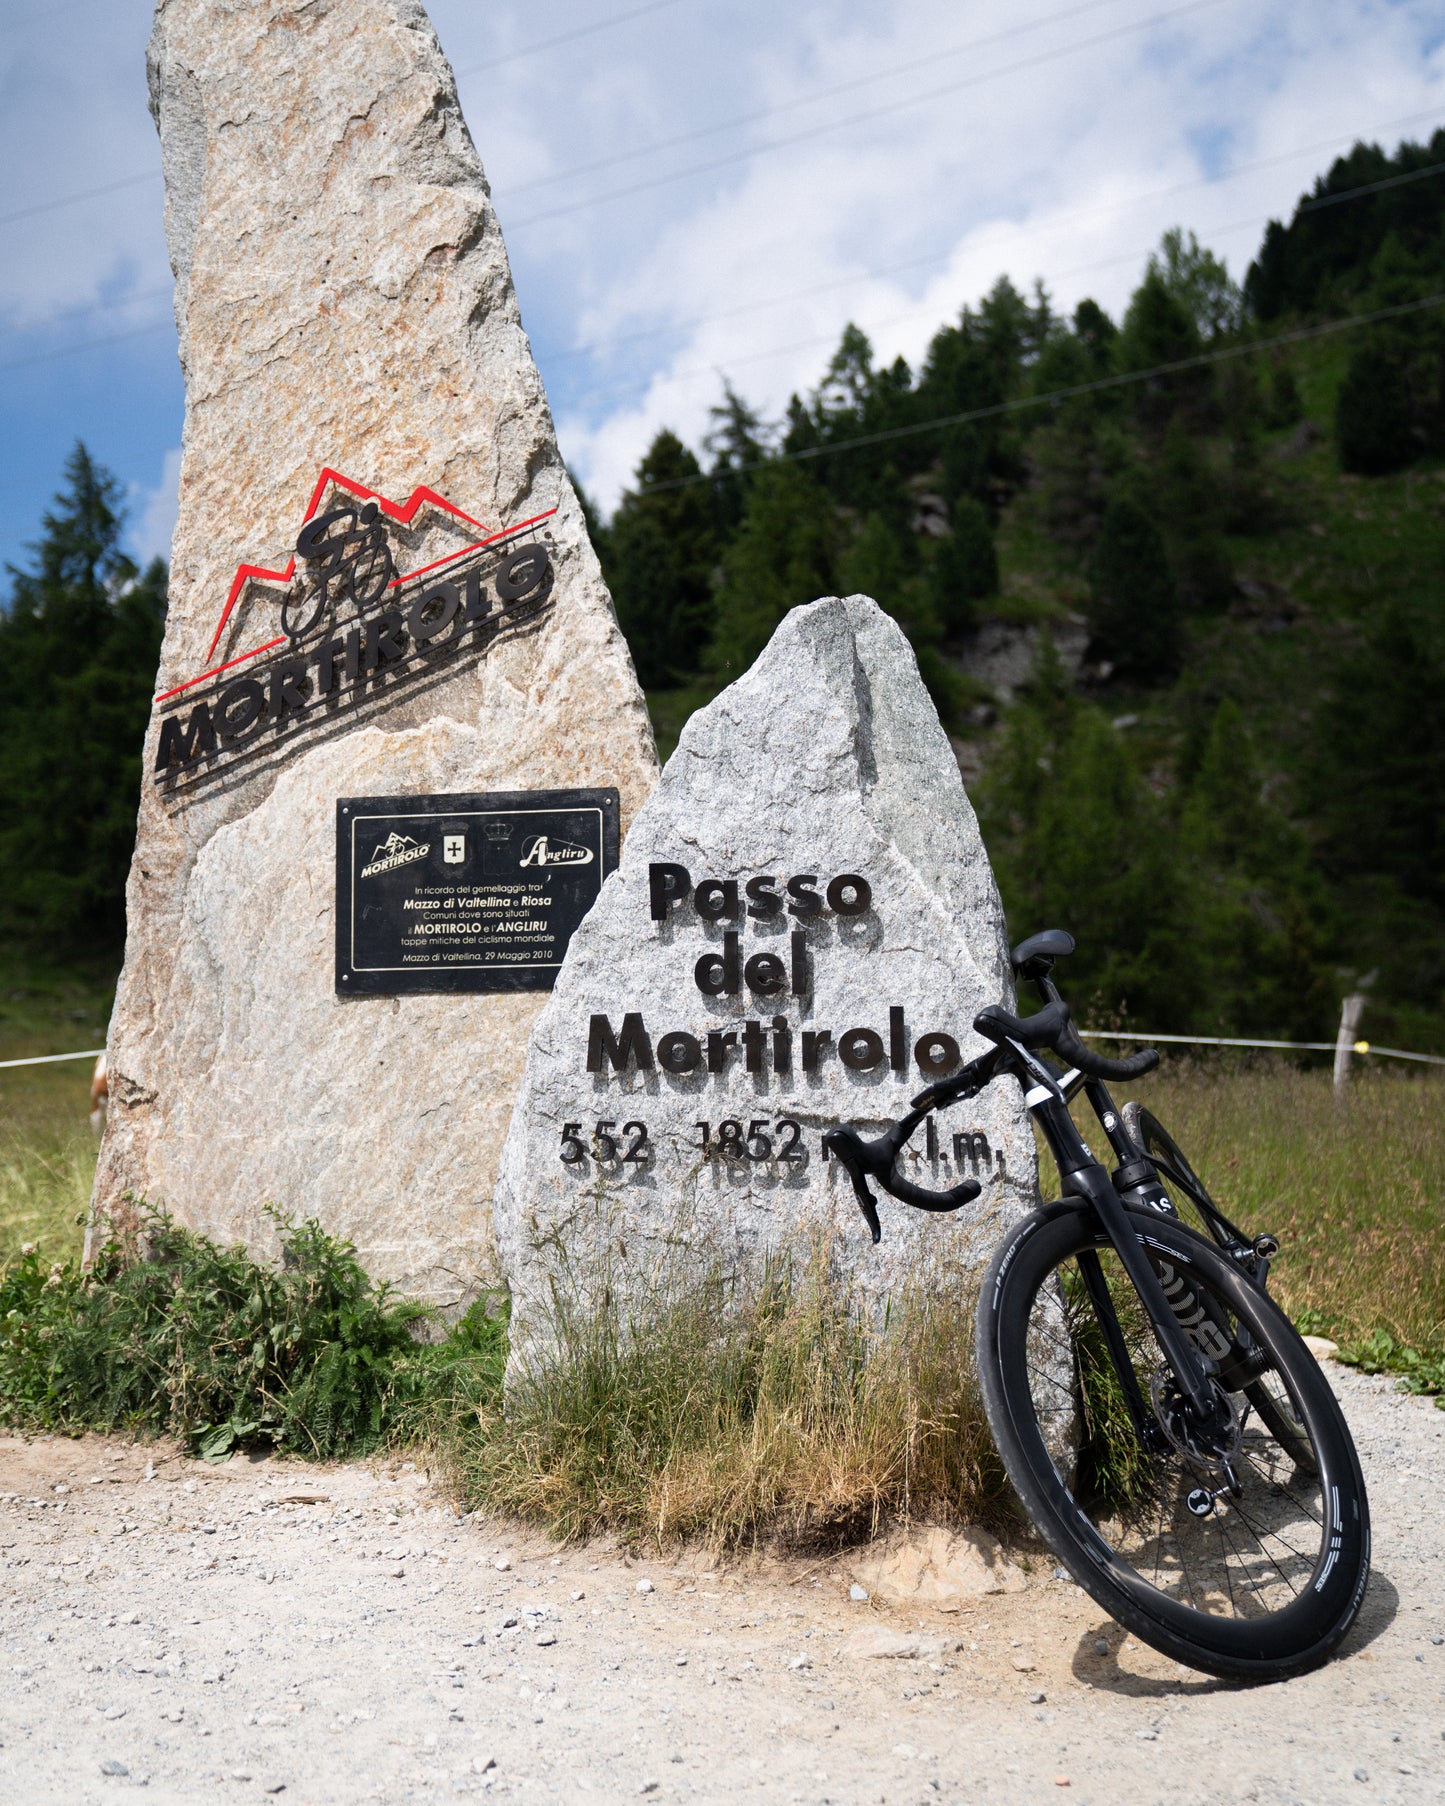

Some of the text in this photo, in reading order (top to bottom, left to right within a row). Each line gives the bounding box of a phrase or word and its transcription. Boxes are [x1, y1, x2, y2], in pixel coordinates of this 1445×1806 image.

[155, 543, 548, 772] MORTIROLO
[361, 845, 429, 878] MORTIROLO
[519, 835, 585, 866] Angliru
[403, 895, 552, 910] Mazzo di Valtellina e Riosa
[414, 887, 423, 895] In
[424, 886, 455, 895] ricordo
[456, 885, 471, 894] del
[472, 884, 526, 895] gemellaggio
[648, 862, 872, 921] Passo
[414, 922, 482, 935] MORTIROLO
[423, 908, 530, 920] Comuni dove sono situati
[401, 934, 555, 947] tappe mitiche del ciclismo mondiale
[403, 953, 430, 962] Mazzo
[431, 953, 440, 962] di
[484, 951, 496, 960] 29
[496, 951, 531, 961] Maggio
[532, 950, 553, 959] 2010
[694, 931, 807, 996] del
[586, 1006, 961, 1075] Mortirolo
[559, 1120, 648, 1164] 552
[695, 1119, 803, 1162] 1852
[999, 1245, 1016, 1277] ZERO
